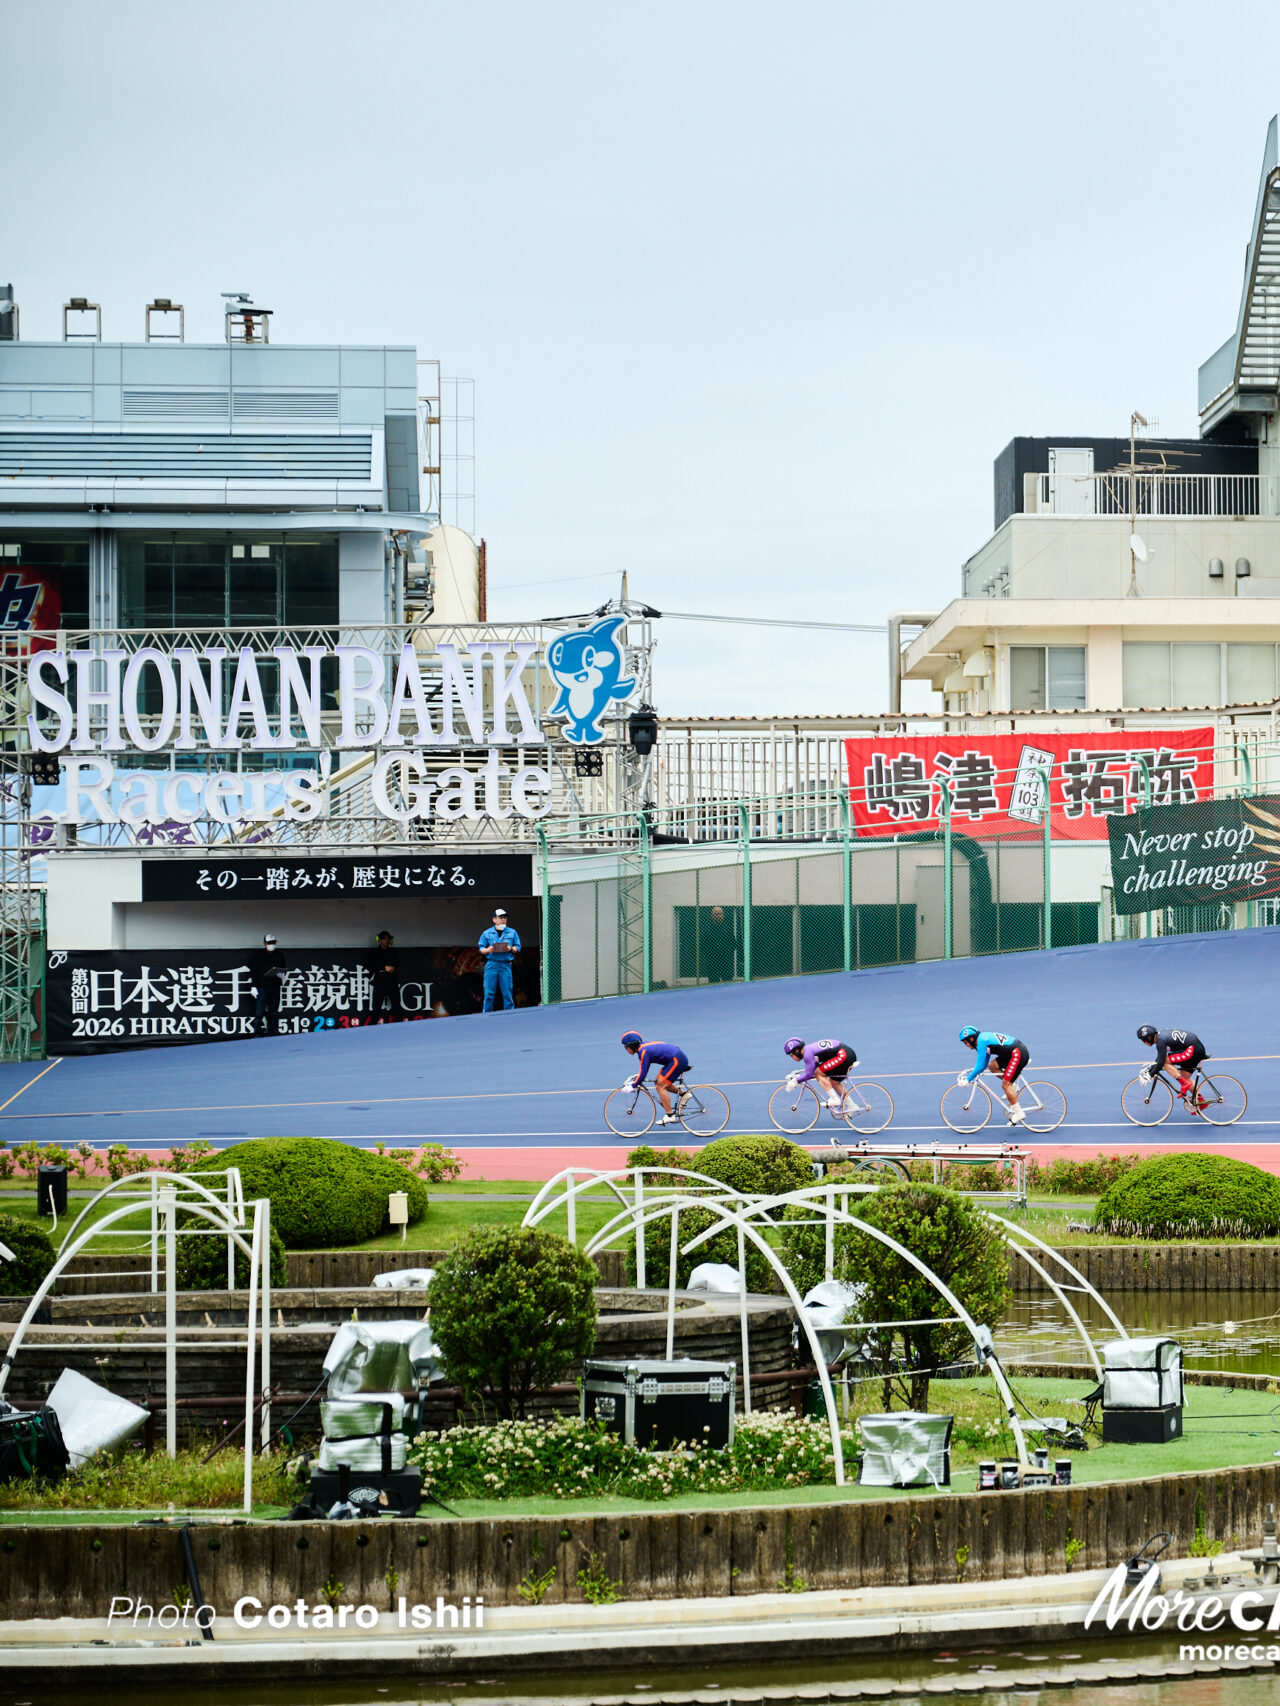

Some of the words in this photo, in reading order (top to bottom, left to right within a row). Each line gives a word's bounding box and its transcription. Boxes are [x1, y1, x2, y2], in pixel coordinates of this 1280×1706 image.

[27, 646, 327, 753] SHONAN
[335, 642, 544, 747] BANK
[58, 752, 332, 825] Racers'
[372, 749, 551, 820] Gate
[864, 751, 999, 820] 嶋津
[1120, 829, 1198, 860] Never
[1201, 824, 1255, 853] stop
[195, 865, 477, 891] その一踏みが、歴史になる。
[1123, 855, 1269, 894] challenging
[71, 968, 89, 1014] 第80回
[72, 1018, 125, 1037] 2026
[129, 1016, 268, 1036] HIRATSUK
[278, 1016, 299, 1034] 5.1
[994, 1032, 1008, 1046] 4
[1171, 1030, 1187, 1044] 2
[818, 1040, 833, 1049] 9
